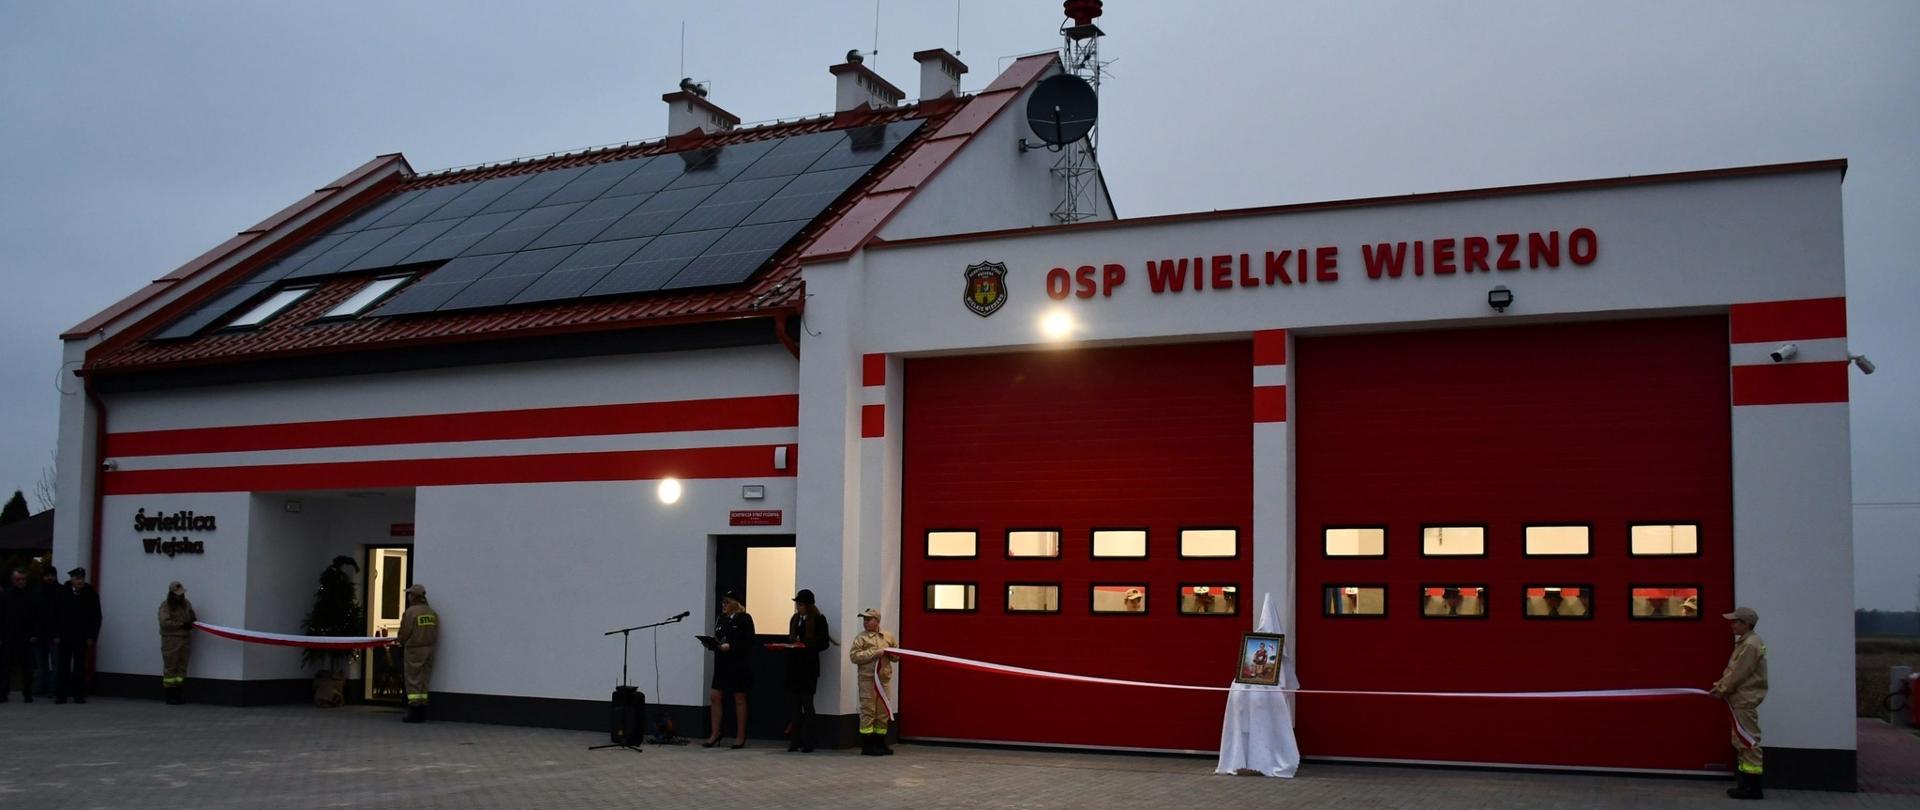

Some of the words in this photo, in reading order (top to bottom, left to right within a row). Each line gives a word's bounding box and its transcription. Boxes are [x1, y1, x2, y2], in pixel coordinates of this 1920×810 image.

[1046, 264, 1126, 299] OSP
[1147, 247, 1338, 293] WIELKIE
[1362, 228, 1598, 278] WIERZNO
[134, 507, 217, 532] Świetlica
[142, 536, 205, 558] Wiejska
